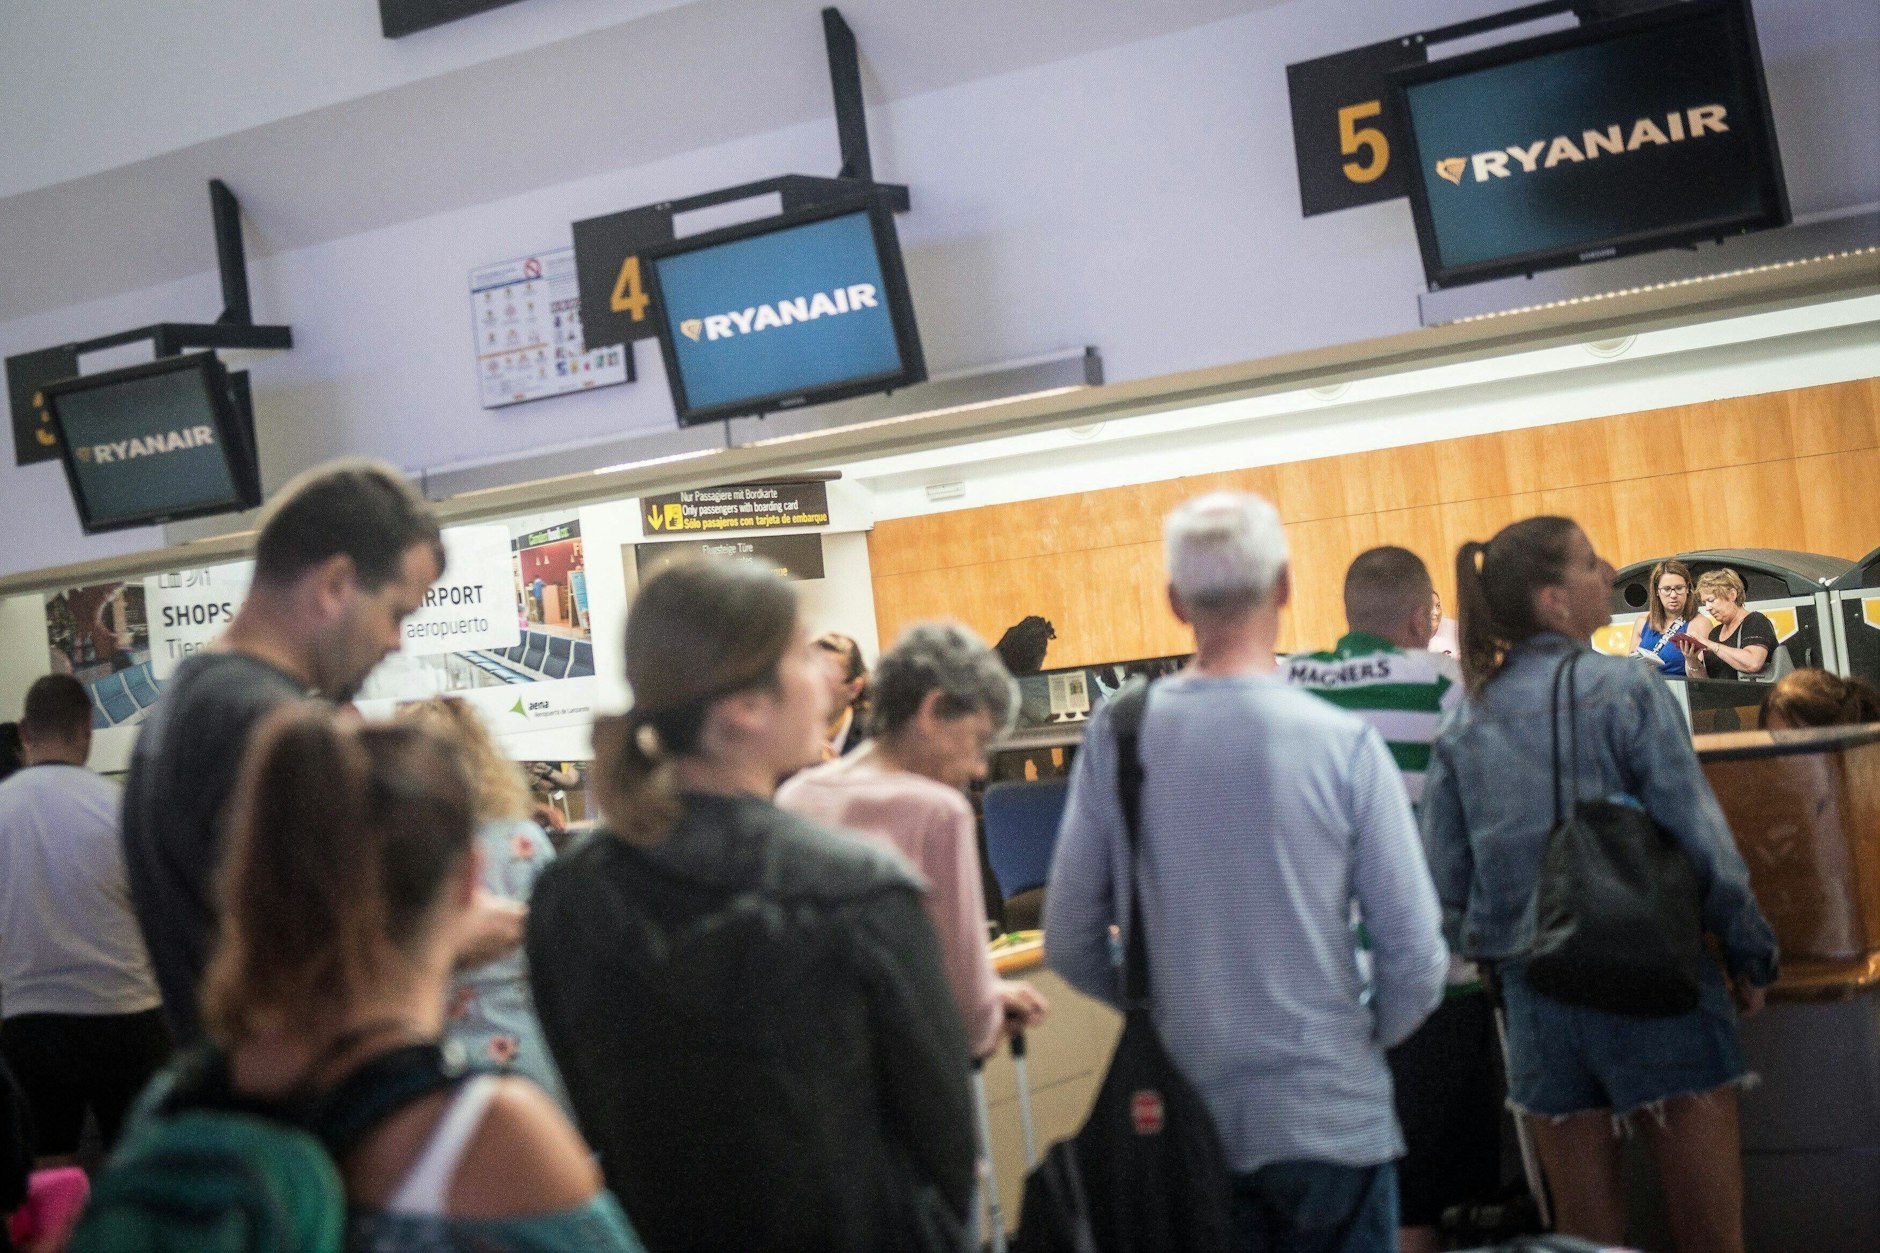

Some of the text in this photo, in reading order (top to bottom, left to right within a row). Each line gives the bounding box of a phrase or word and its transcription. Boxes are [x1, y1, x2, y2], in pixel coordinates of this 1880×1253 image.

[1336, 99, 1391, 184] 5
[1473, 102, 1730, 184] RYANAIR
[609, 255, 650, 322] 4
[705, 282, 878, 342] RYANAIR
[93, 424, 215, 465] RYANAIR
[680, 488, 778, 503] Nur Passagiere mit Bordkarte
[682, 499, 799, 517] Only passengers with boarding card
[684, 512, 827, 530] Sólo pasajeros con tarjeta de embarque
[420, 584, 483, 607] RPORT
[162, 602, 233, 627] SHOPS
[406, 617, 489, 640] aeropuerto
[1288, 658, 1391, 685] MAGNERS
